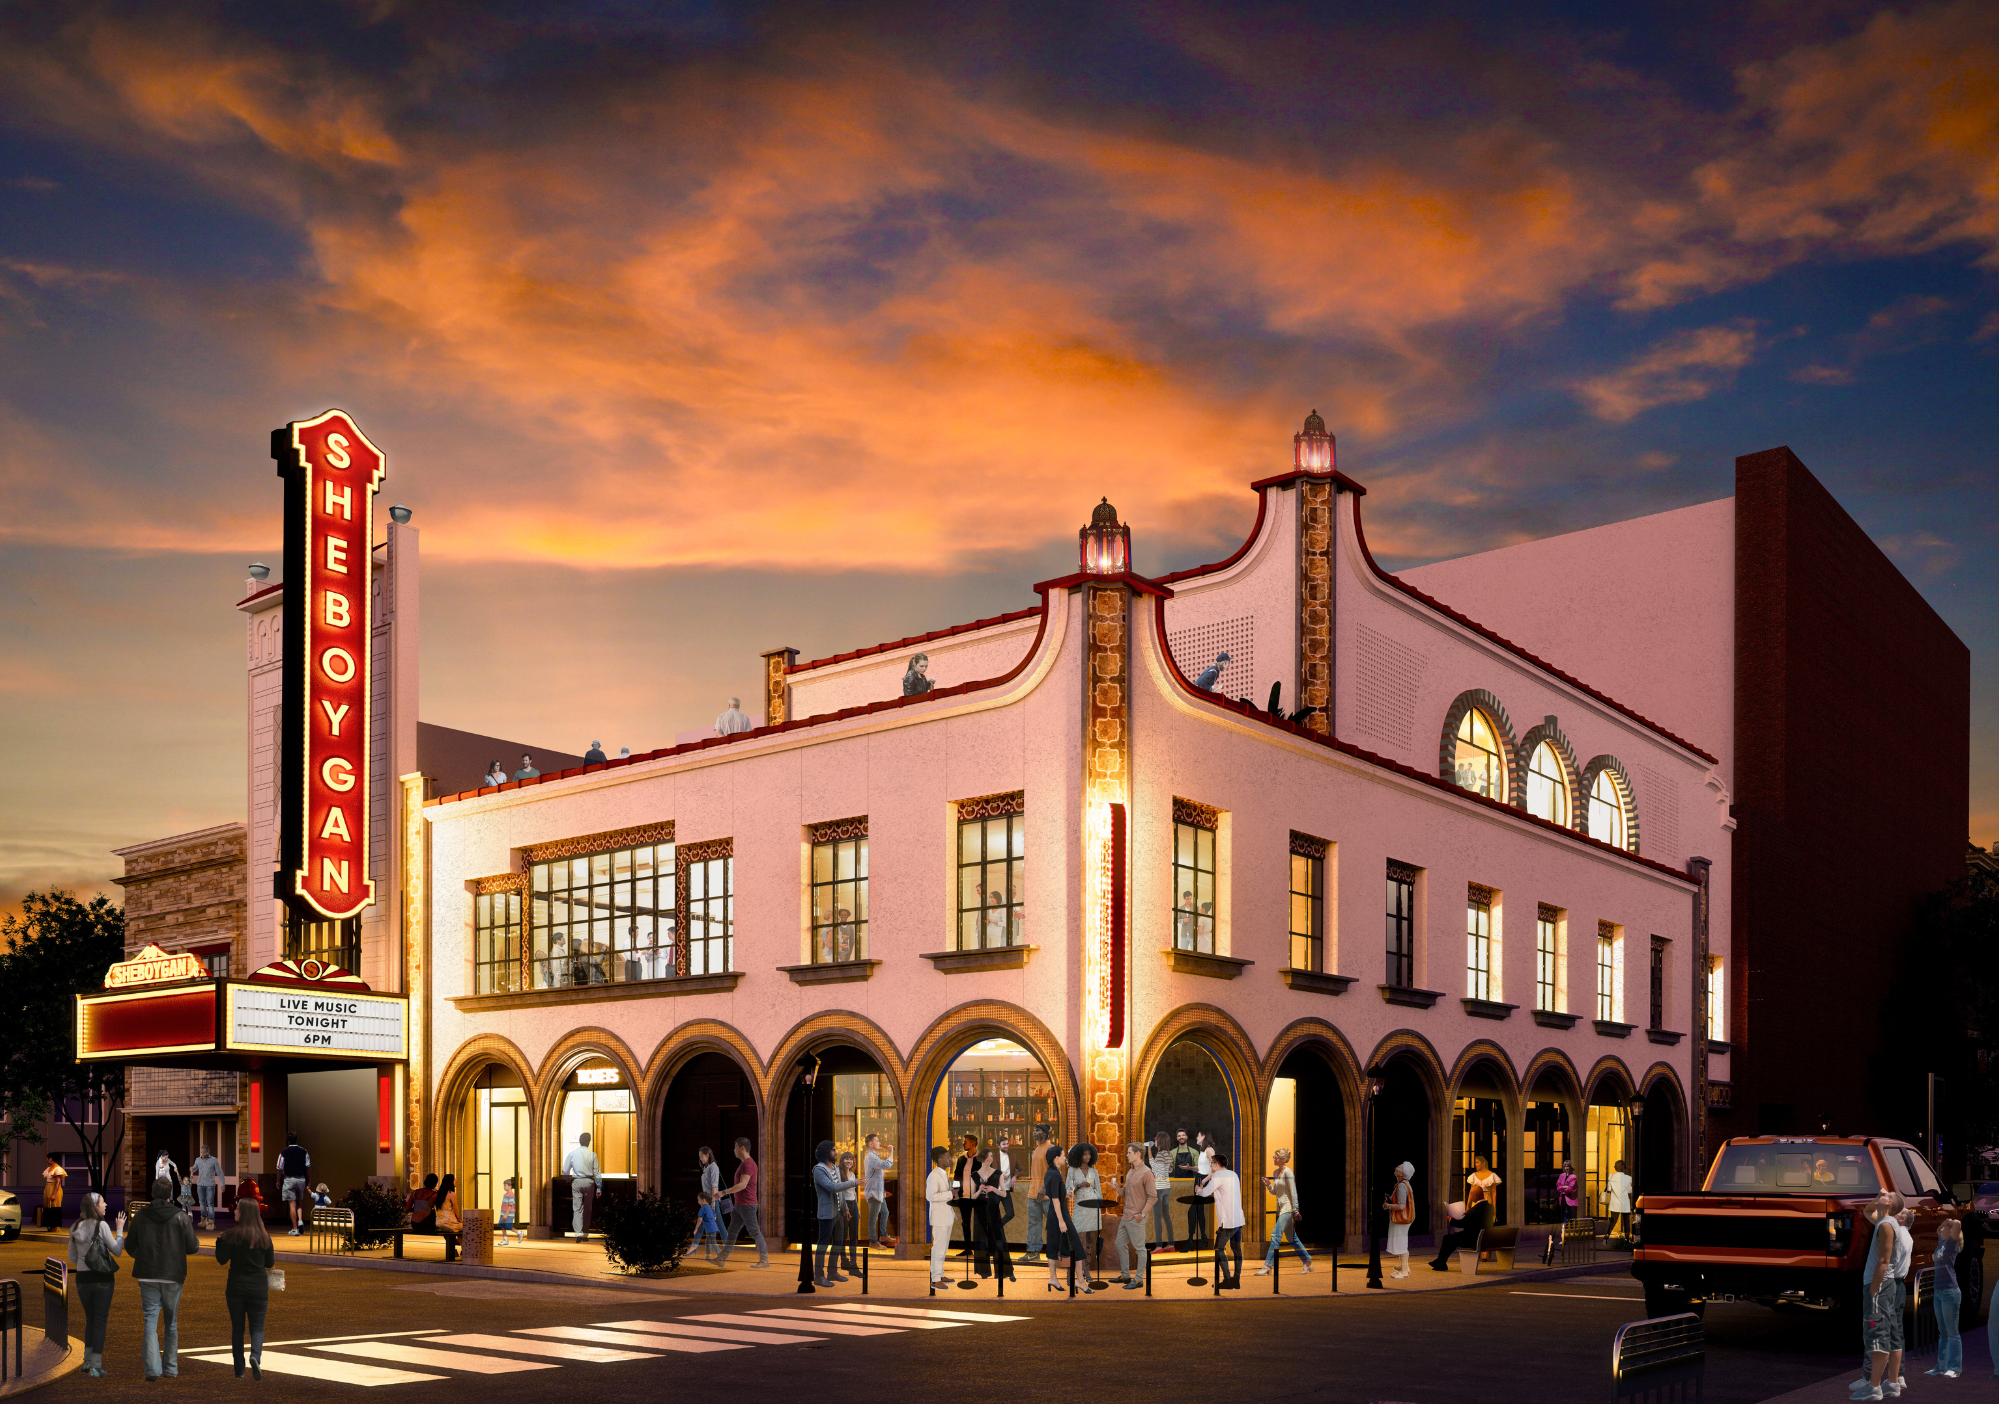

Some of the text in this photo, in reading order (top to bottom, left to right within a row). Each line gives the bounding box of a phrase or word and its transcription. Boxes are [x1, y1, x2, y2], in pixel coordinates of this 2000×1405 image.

[320, 433, 356, 894] SHEBOYGAN
[114, 958, 187, 984] SHEBOYGAN
[305, 964, 318, 976] S
[280, 998, 357, 1013] LIVE MUSIC
[288, 1015, 348, 1028] TONIGHT
[304, 1034, 331, 1045] 6PM
